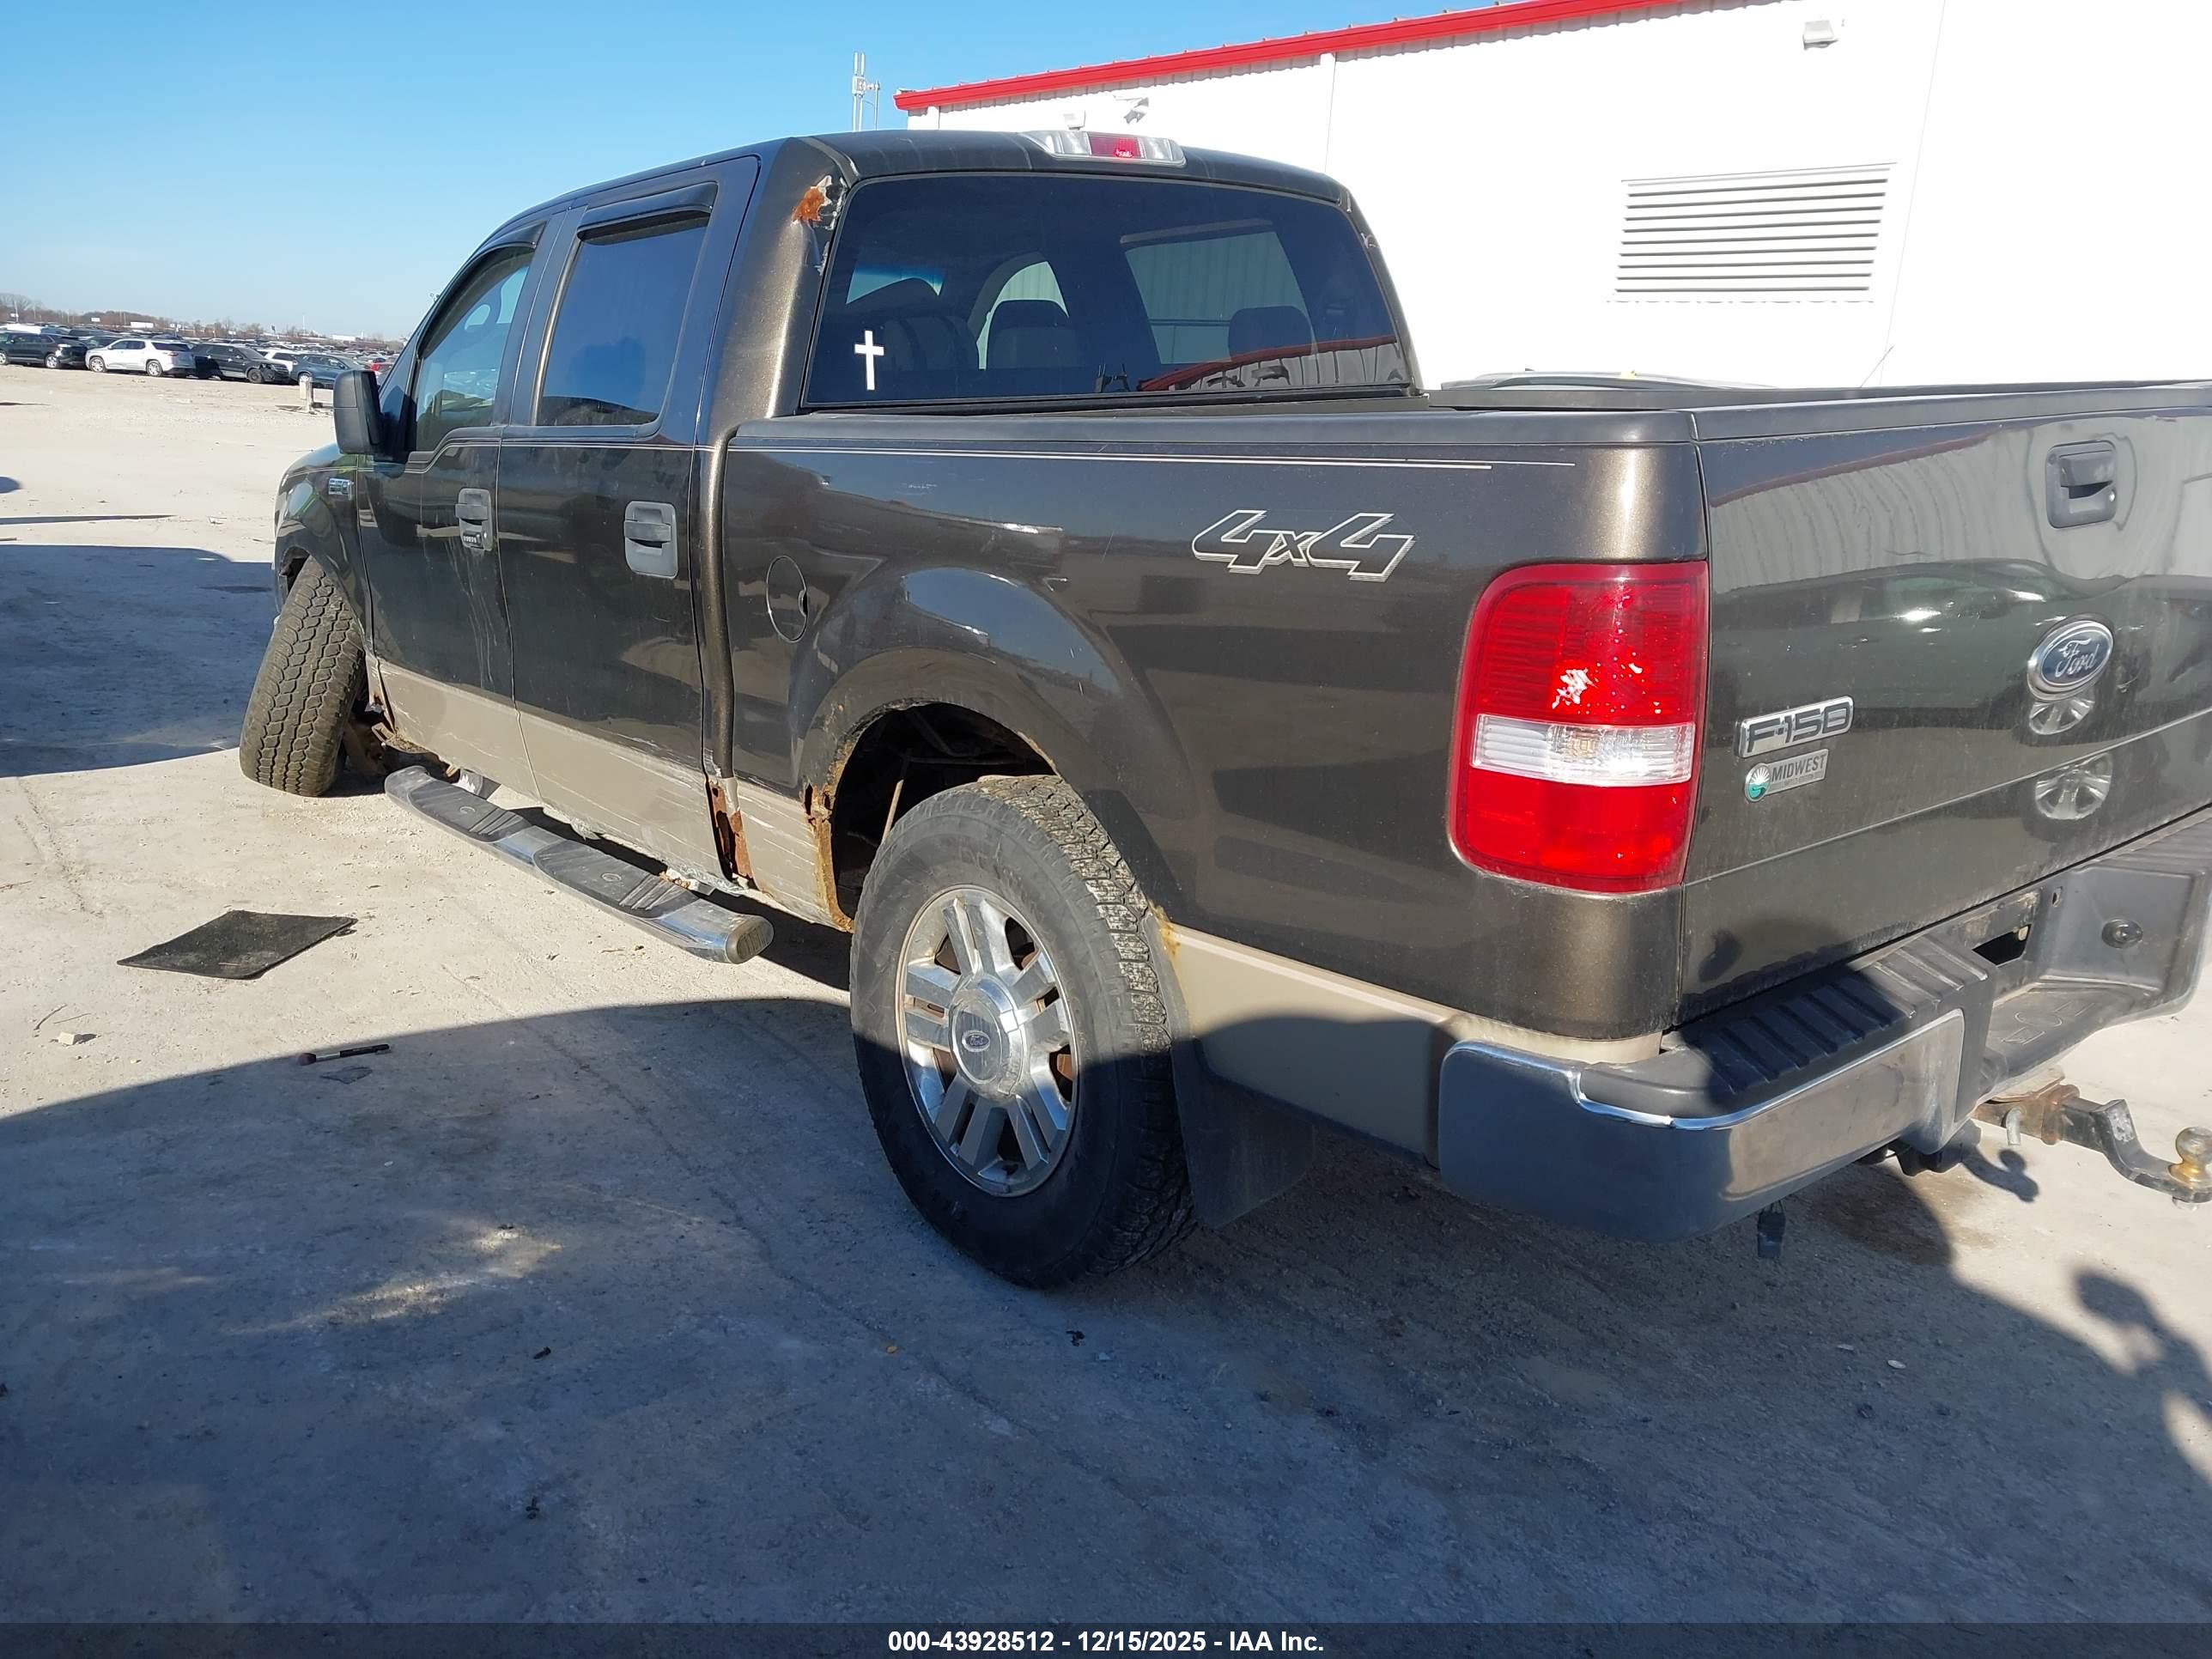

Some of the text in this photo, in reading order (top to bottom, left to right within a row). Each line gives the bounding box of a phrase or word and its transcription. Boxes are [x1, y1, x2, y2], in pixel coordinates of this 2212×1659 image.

[1191, 509, 1416, 583] 4x4
[2054, 638, 2100, 678] Ford
[1771, 753, 1827, 782] MIDWEST
